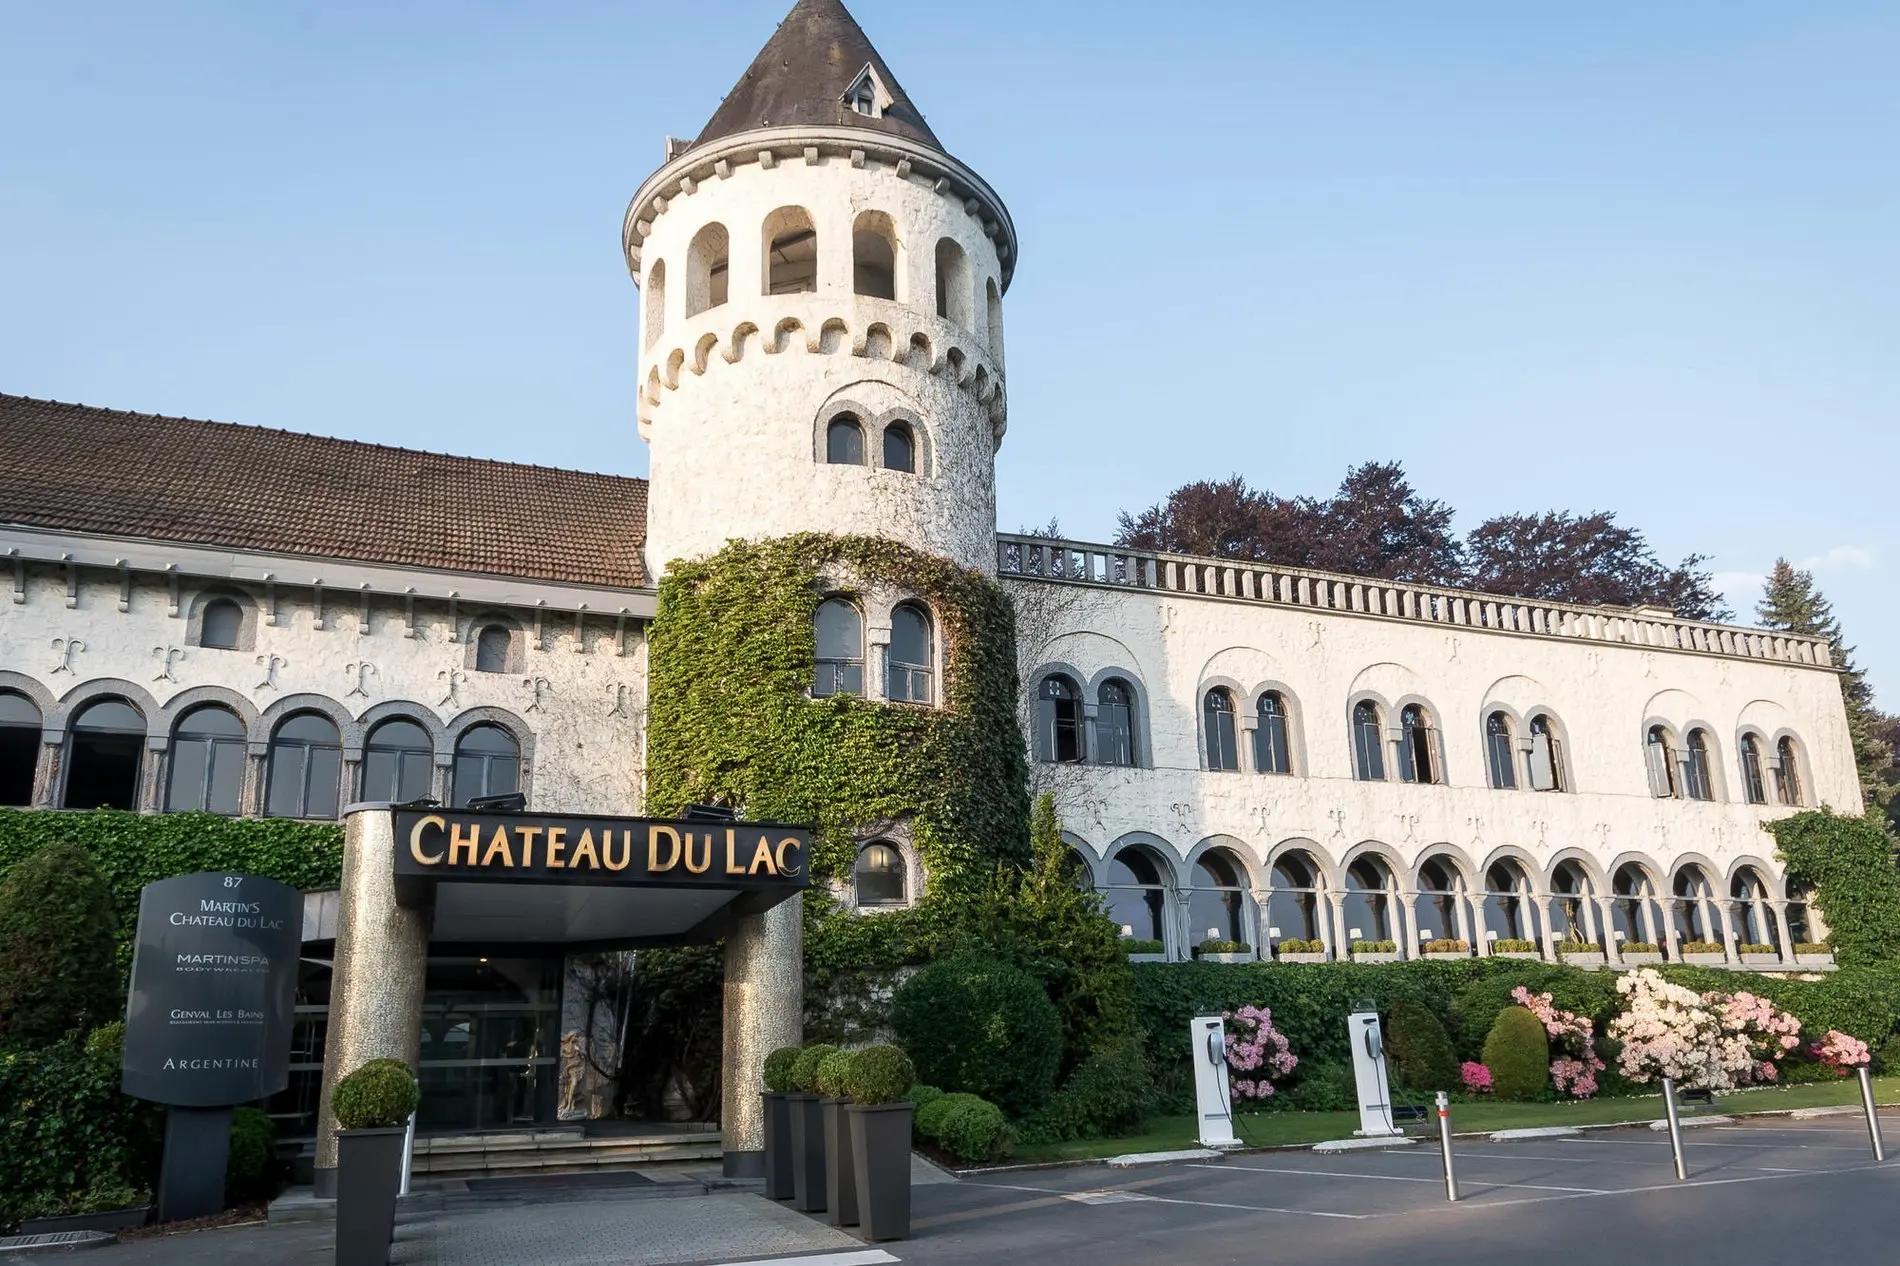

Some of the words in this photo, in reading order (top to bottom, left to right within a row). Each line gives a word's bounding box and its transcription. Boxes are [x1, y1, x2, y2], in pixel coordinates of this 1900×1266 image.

[410, 815, 631, 871] CHATEAU
[648, 825, 712, 873] DU
[726, 828, 801, 878] LAC
[223, 876, 243, 888] 87
[200, 899, 260, 914] MARTIN'S
[169, 912, 234, 927] CHATEAU
[237, 917, 257, 928] DU
[260, 916, 284, 930] LAC
[170, 1009, 210, 1019] GENVAL
[216, 1009, 233, 1019] LES
[237, 1009, 265, 1019] BAINS
[163, 1057, 259, 1070] ARGENTINE
